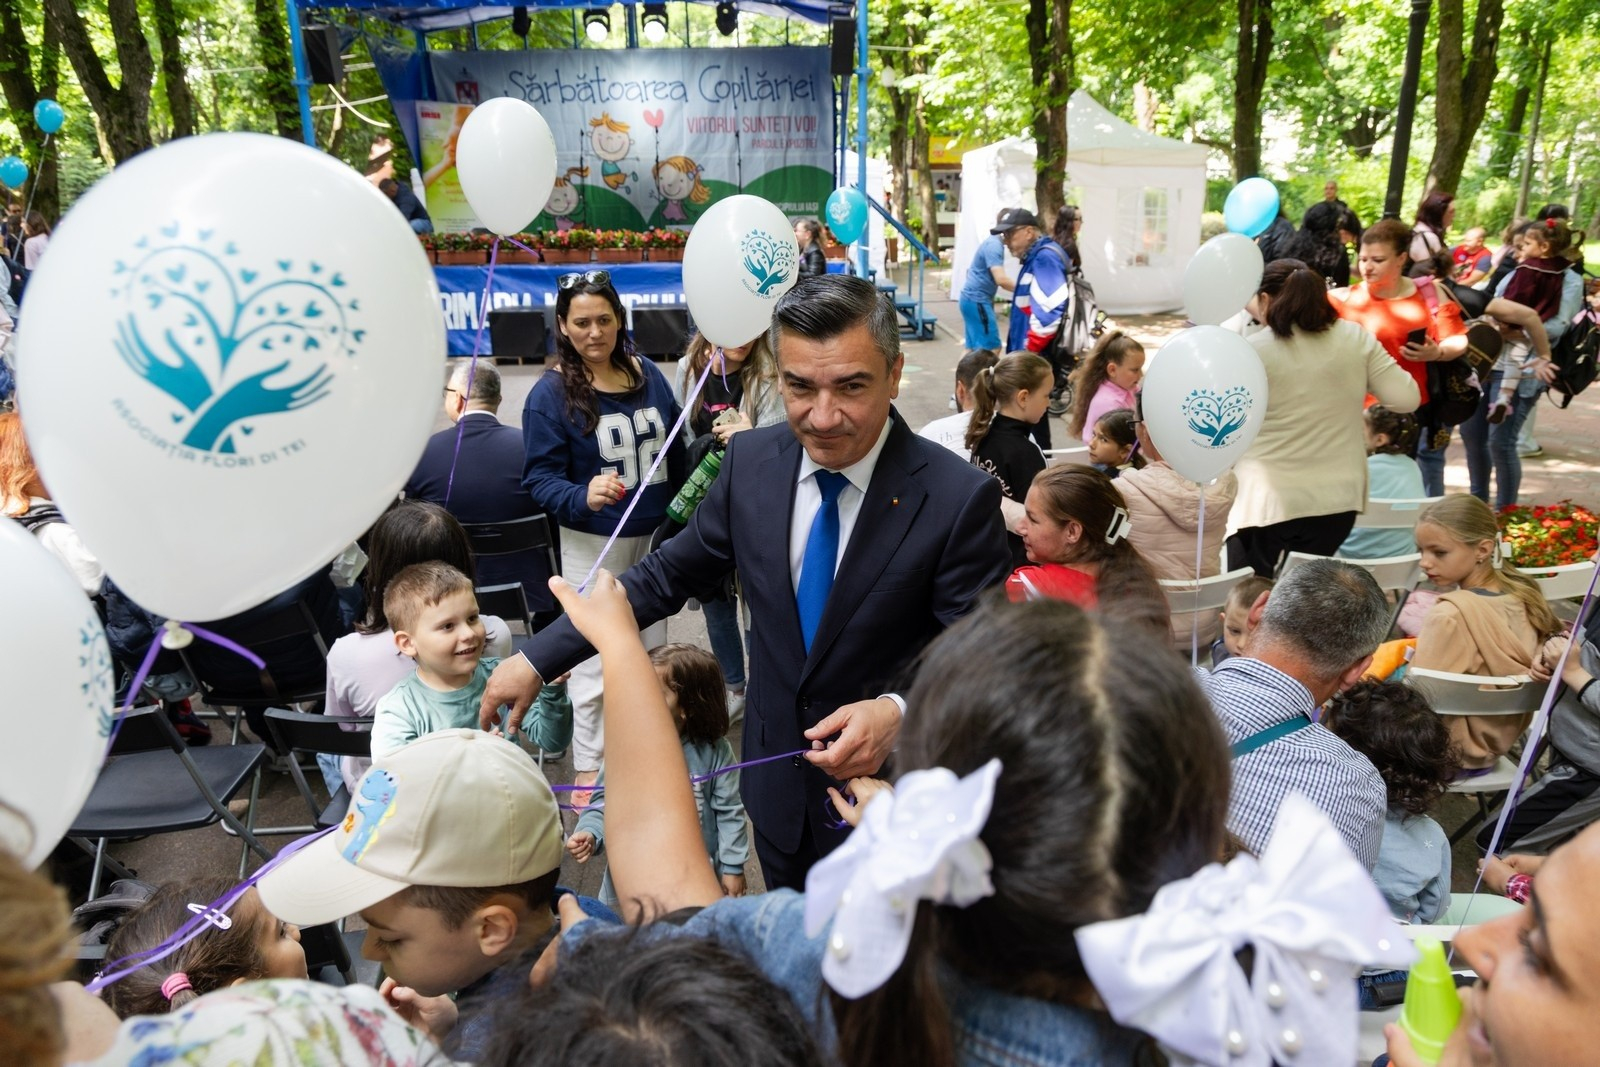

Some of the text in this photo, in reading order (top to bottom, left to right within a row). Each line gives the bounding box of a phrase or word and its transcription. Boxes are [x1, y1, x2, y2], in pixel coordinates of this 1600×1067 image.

[504, 64, 815, 110] Sărbătoarea Copilăriei
[687, 116, 737, 134] VIITORUL
[795, 115, 817, 133] VOI!
[202, 454, 256, 468] FLORI
[260, 451, 279, 465] DI
[281, 438, 308, 457] TEI
[595, 406, 669, 490] 92
